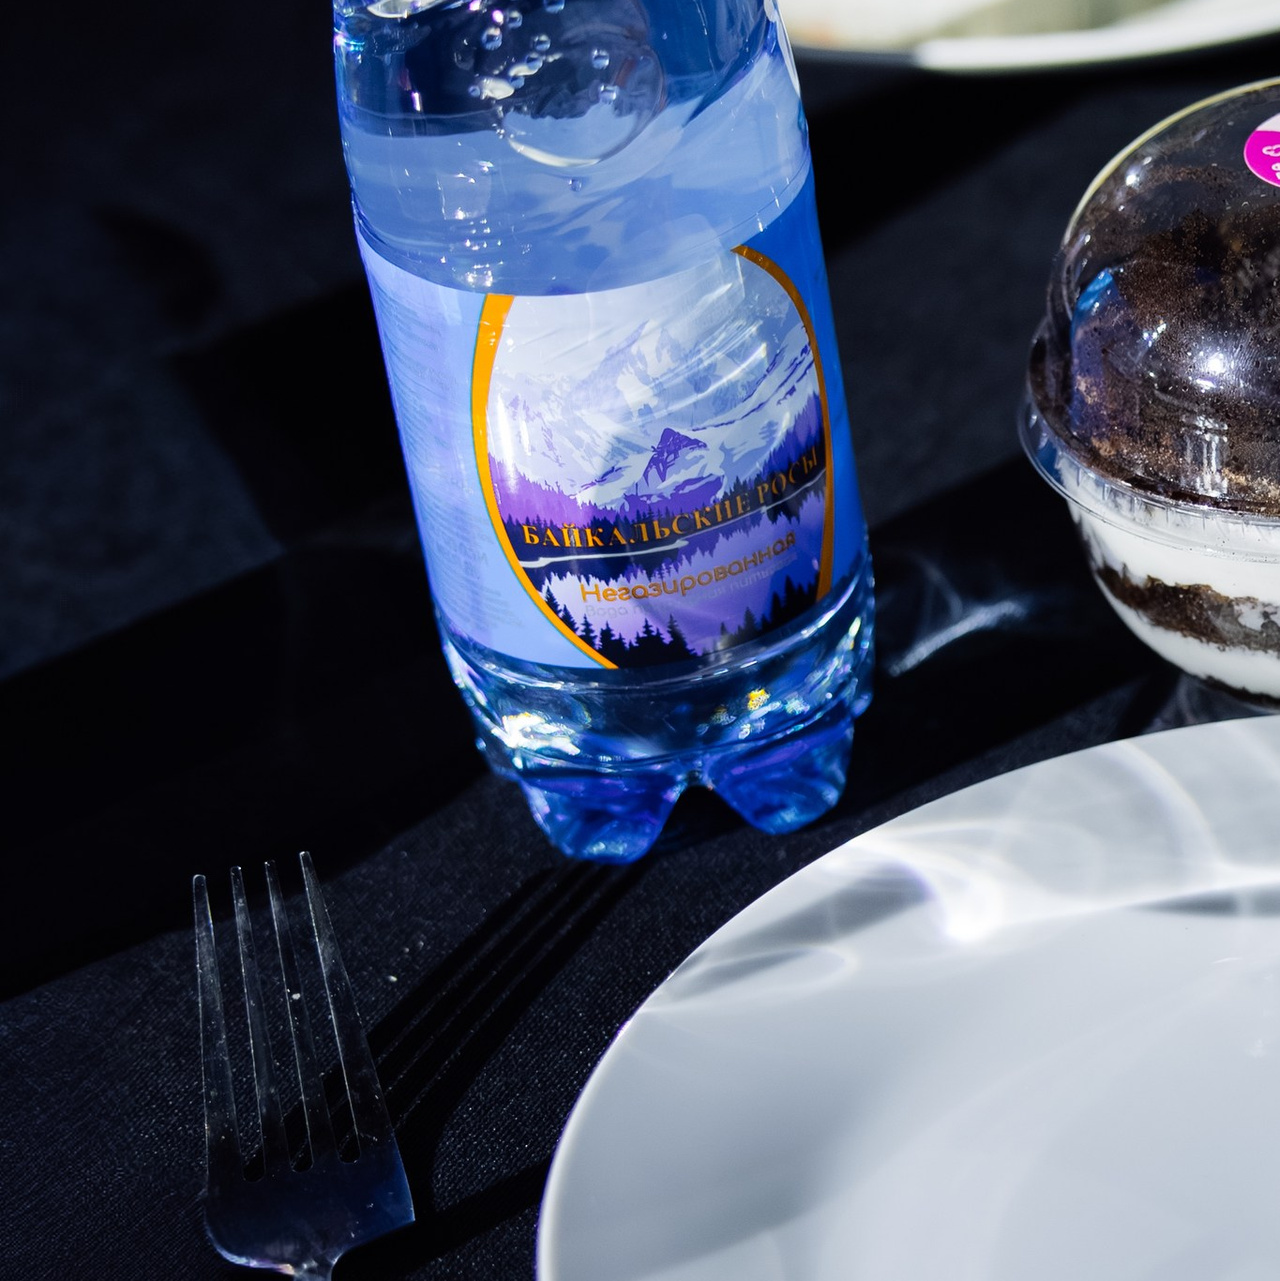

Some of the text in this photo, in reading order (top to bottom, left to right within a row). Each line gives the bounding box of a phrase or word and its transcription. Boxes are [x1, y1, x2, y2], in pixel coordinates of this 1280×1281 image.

[522, 445, 818, 548] БАЙКАЛЬСКИЕ РОСЫ
[579, 530, 797, 604] Негазированная
